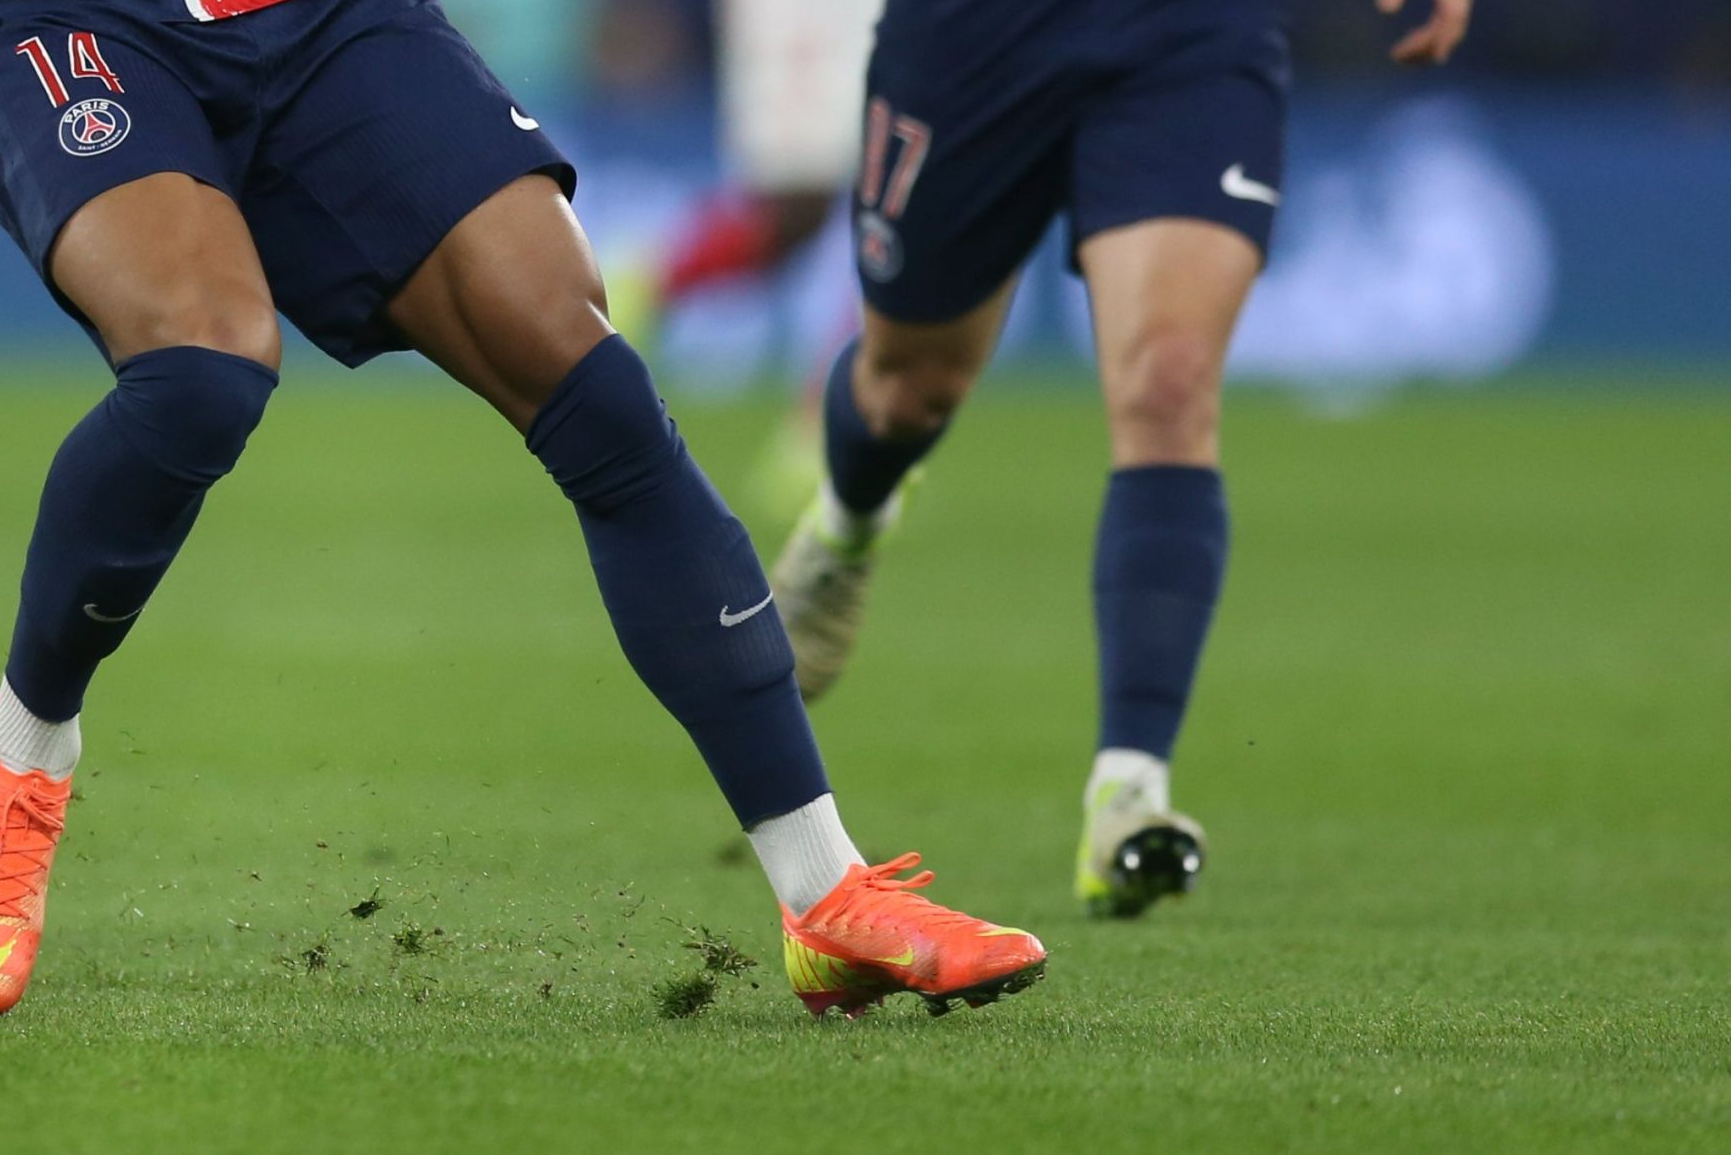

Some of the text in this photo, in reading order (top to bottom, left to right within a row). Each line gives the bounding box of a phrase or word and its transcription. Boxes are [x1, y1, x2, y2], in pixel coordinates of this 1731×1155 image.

[15, 31, 125, 108] 14
[64, 101, 109, 123] PARIS
[861, 98, 931, 218] 17
